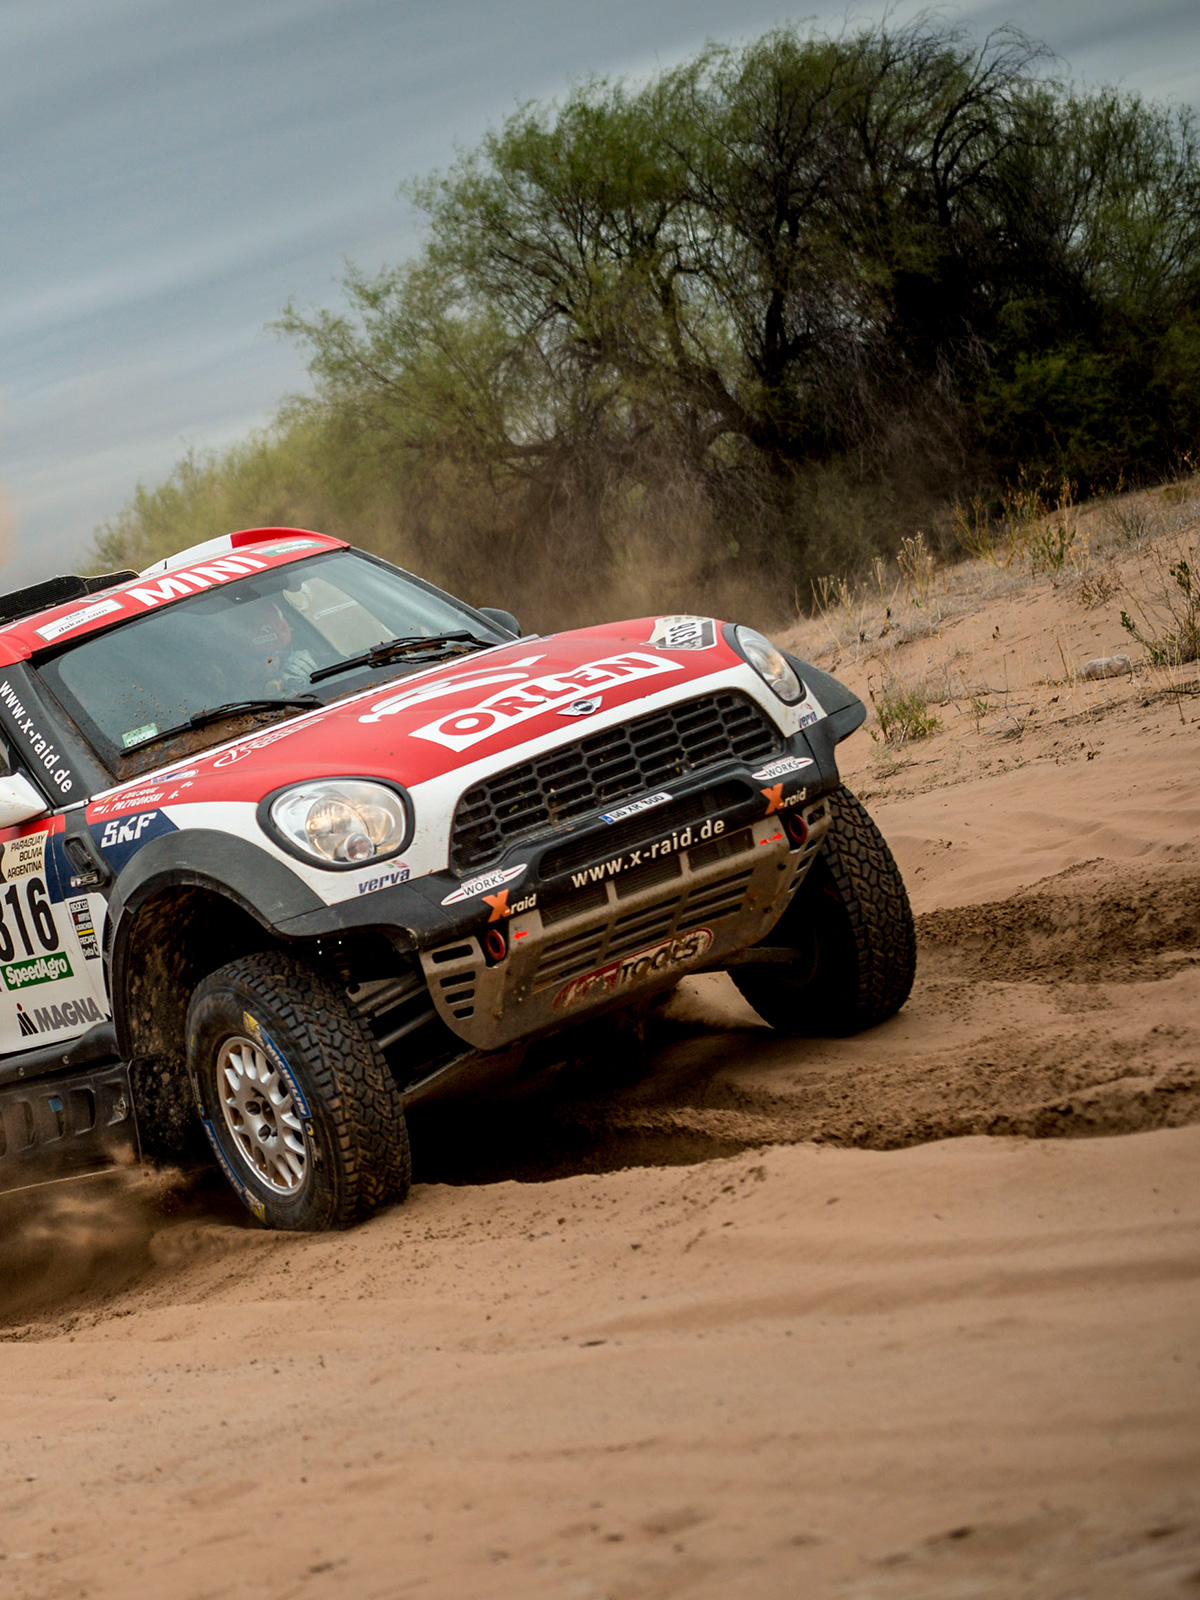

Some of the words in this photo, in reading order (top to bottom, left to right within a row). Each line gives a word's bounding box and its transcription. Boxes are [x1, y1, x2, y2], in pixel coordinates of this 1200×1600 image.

[125, 555, 268, 607] MINI
[58, 608, 108, 633] dakar.com
[439, 656, 660, 736] ORLEN
[798, 711, 819, 729] verva
[0, 680, 73, 793] www.x-raid.de
[765, 760, 799, 777] WORKS
[110, 791, 165, 812] PRZYGONSKI
[626, 803, 643, 812] XR
[643, 795, 665, 806] 600
[101, 812, 157, 848] SKF
[10, 834, 46, 852] PARAGUAY
[19, 847, 43, 862] BOLIVIA
[571, 819, 725, 889] www.x-raid.de
[7, 860, 43, 879] ARGENTINA
[358, 868, 411, 894] verva
[463, 873, 505, 896] WORKS
[5, 957, 68, 987] SpeedAgro
[33, 997, 104, 1032] MAGNA
[265, 1043, 307, 1116] MICHELIN
